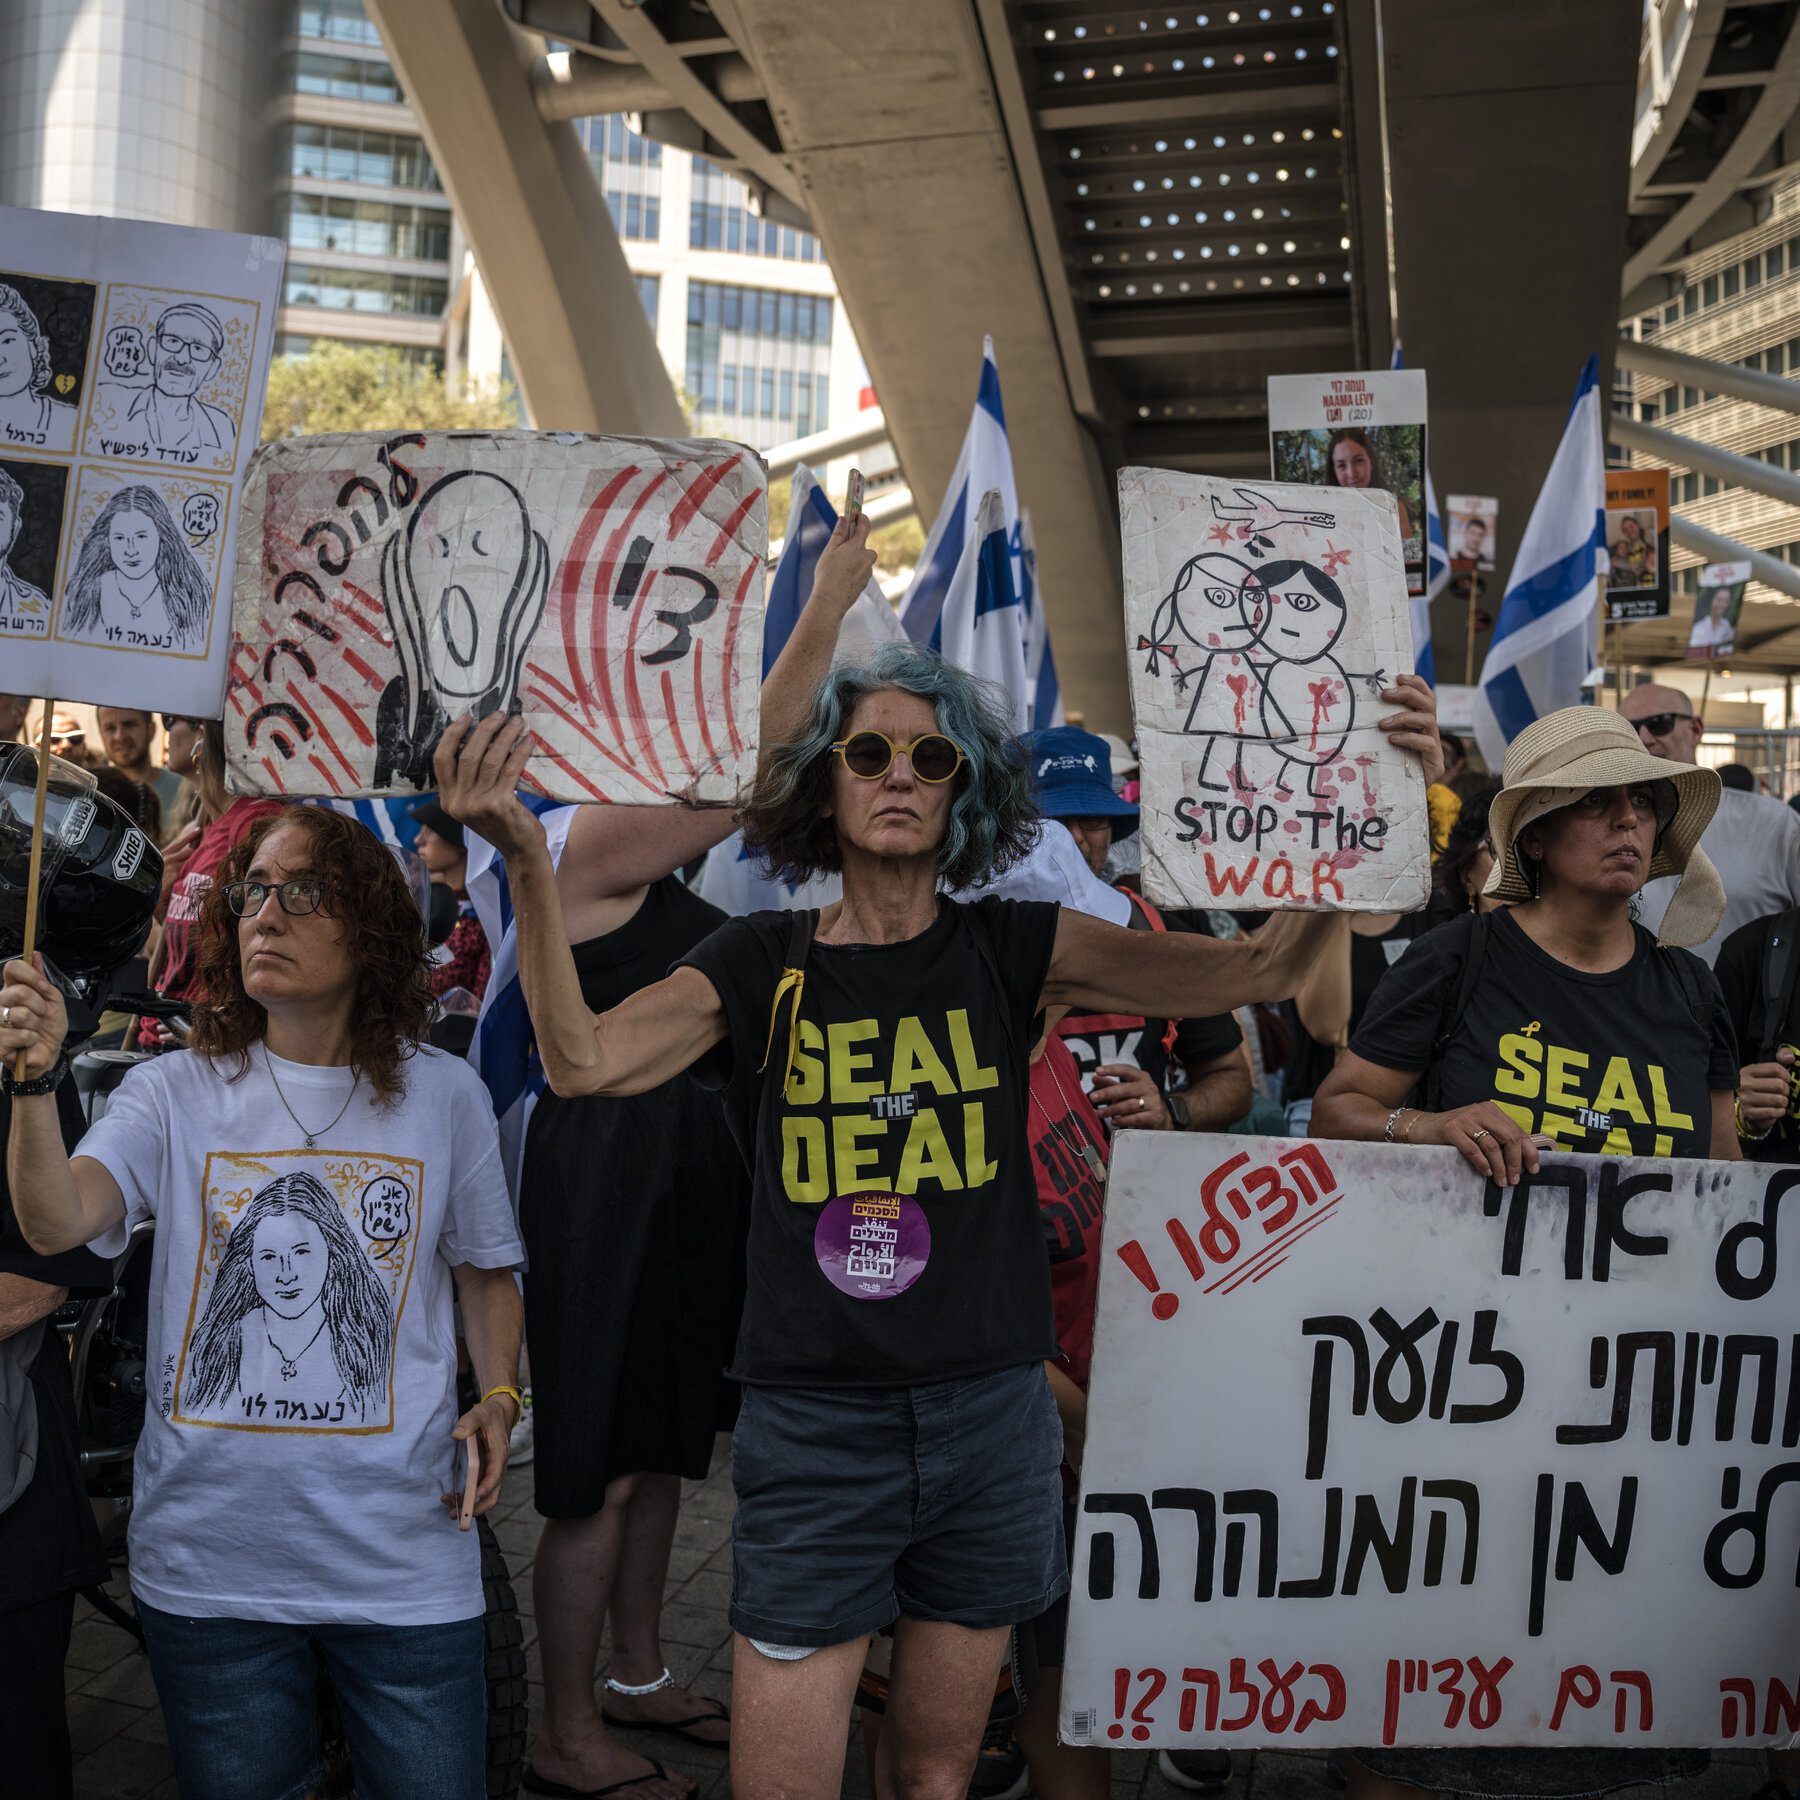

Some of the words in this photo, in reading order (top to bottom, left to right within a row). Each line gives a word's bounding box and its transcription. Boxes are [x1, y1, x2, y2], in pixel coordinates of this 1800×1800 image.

[116, 331, 135, 346] אני
[111, 345, 140, 362] עדיין
[1322, 394, 1354, 408] NAAMA
[1355, 393, 1374, 406] LEVY
[1348, 408, 1373, 422] (20)
[6, 422, 46, 445] כרמל
[100, 438, 149, 458] ליפשיץ
[156, 447, 199, 463] עודד
[105, 625, 122, 642] לוי
[127, 631, 172, 648] נעמה
[1174, 796, 1278, 852] STOP
[117, 832, 141, 874] SHOEI
[784, 1008, 999, 1105] SEAL
[1494, 1033, 1695, 1131] SEAL
[872, 1094, 916, 1118] THE
[1577, 1107, 1612, 1131] THE
[781, 1102, 999, 1204] DEAL
[380, 1184, 403, 1201] אני
[368, 1202, 403, 1221] עדיין
[854, 1205, 898, 1217] הסכמים
[852, 1228, 895, 1240] מצילים
[1483, 1163, 1673, 1283] אחי
[849, 1242, 895, 1260] الأرواح
[850, 1259, 892, 1274] חיים
[241, 1392, 268, 1418] לוי
[274, 1399, 346, 1422] נעמה
[1084, 1476, 1480, 1603] המנהרה
[1528, 1474, 1638, 1637] מן
[1382, 1656, 1513, 1746] עדיין
[1549, 1663, 1653, 1733] הם
